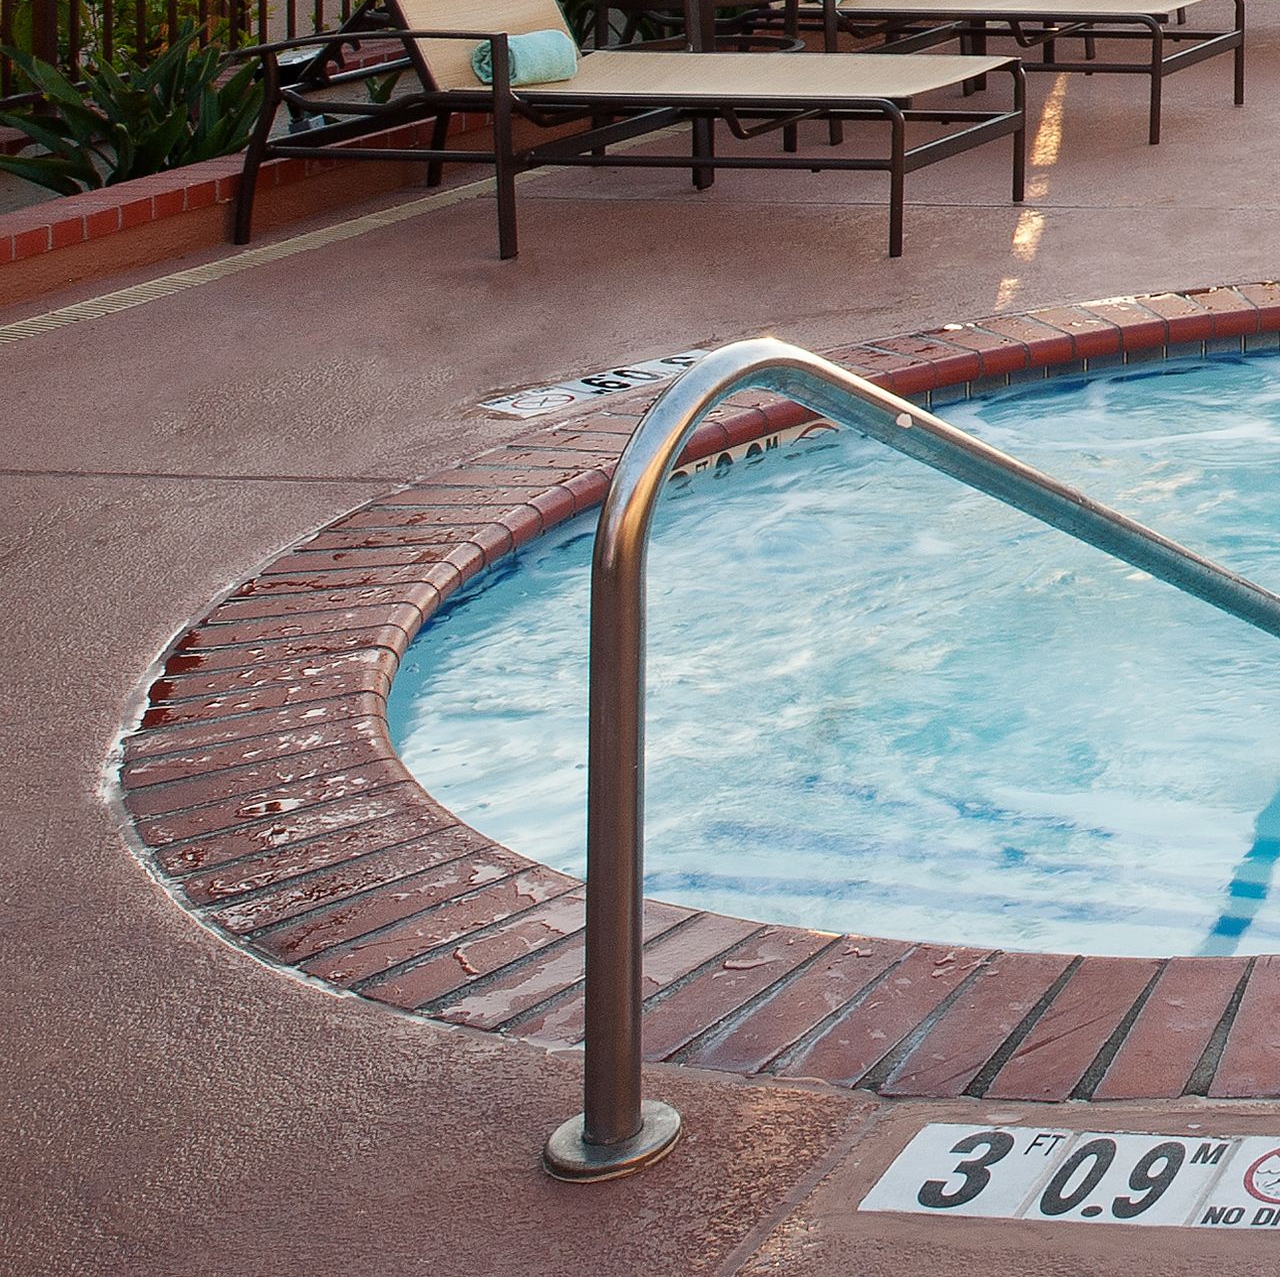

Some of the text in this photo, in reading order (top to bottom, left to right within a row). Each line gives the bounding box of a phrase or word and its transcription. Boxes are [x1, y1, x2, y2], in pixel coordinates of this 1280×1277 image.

[917, 1131, 1230, 1220] 3 FT 0.9 M
[1200, 1206, 1246, 1226] NO
